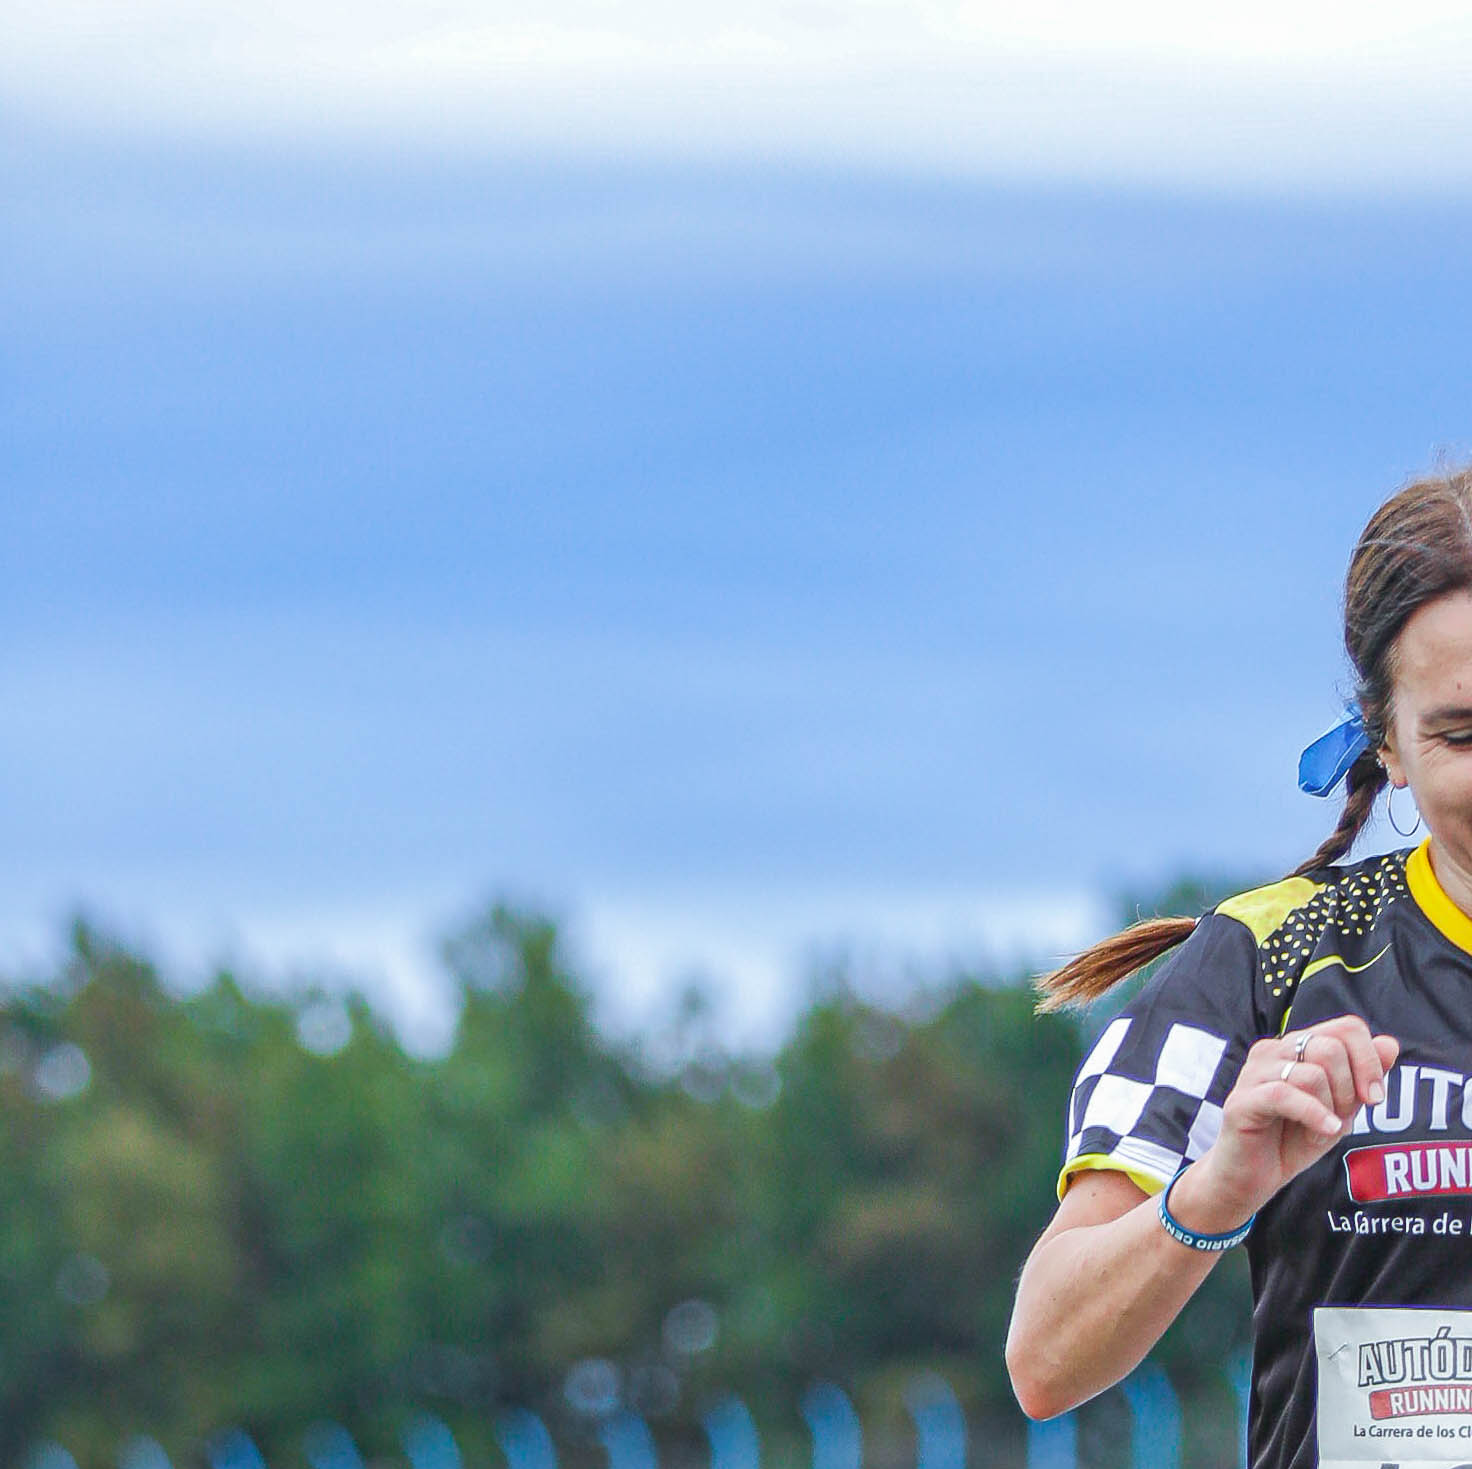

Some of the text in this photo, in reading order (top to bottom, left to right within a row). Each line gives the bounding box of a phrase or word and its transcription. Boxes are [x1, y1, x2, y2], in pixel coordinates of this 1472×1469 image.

[1327, 1210, 1351, 1233] La
[1432, 1212, 1463, 1236] de
[1353, 1424, 1366, 1437] La
[1368, 1424, 1414, 1438] Carrera
[1416, 1425, 1433, 1438] de
[1436, 1425, 1455, 1438] los
